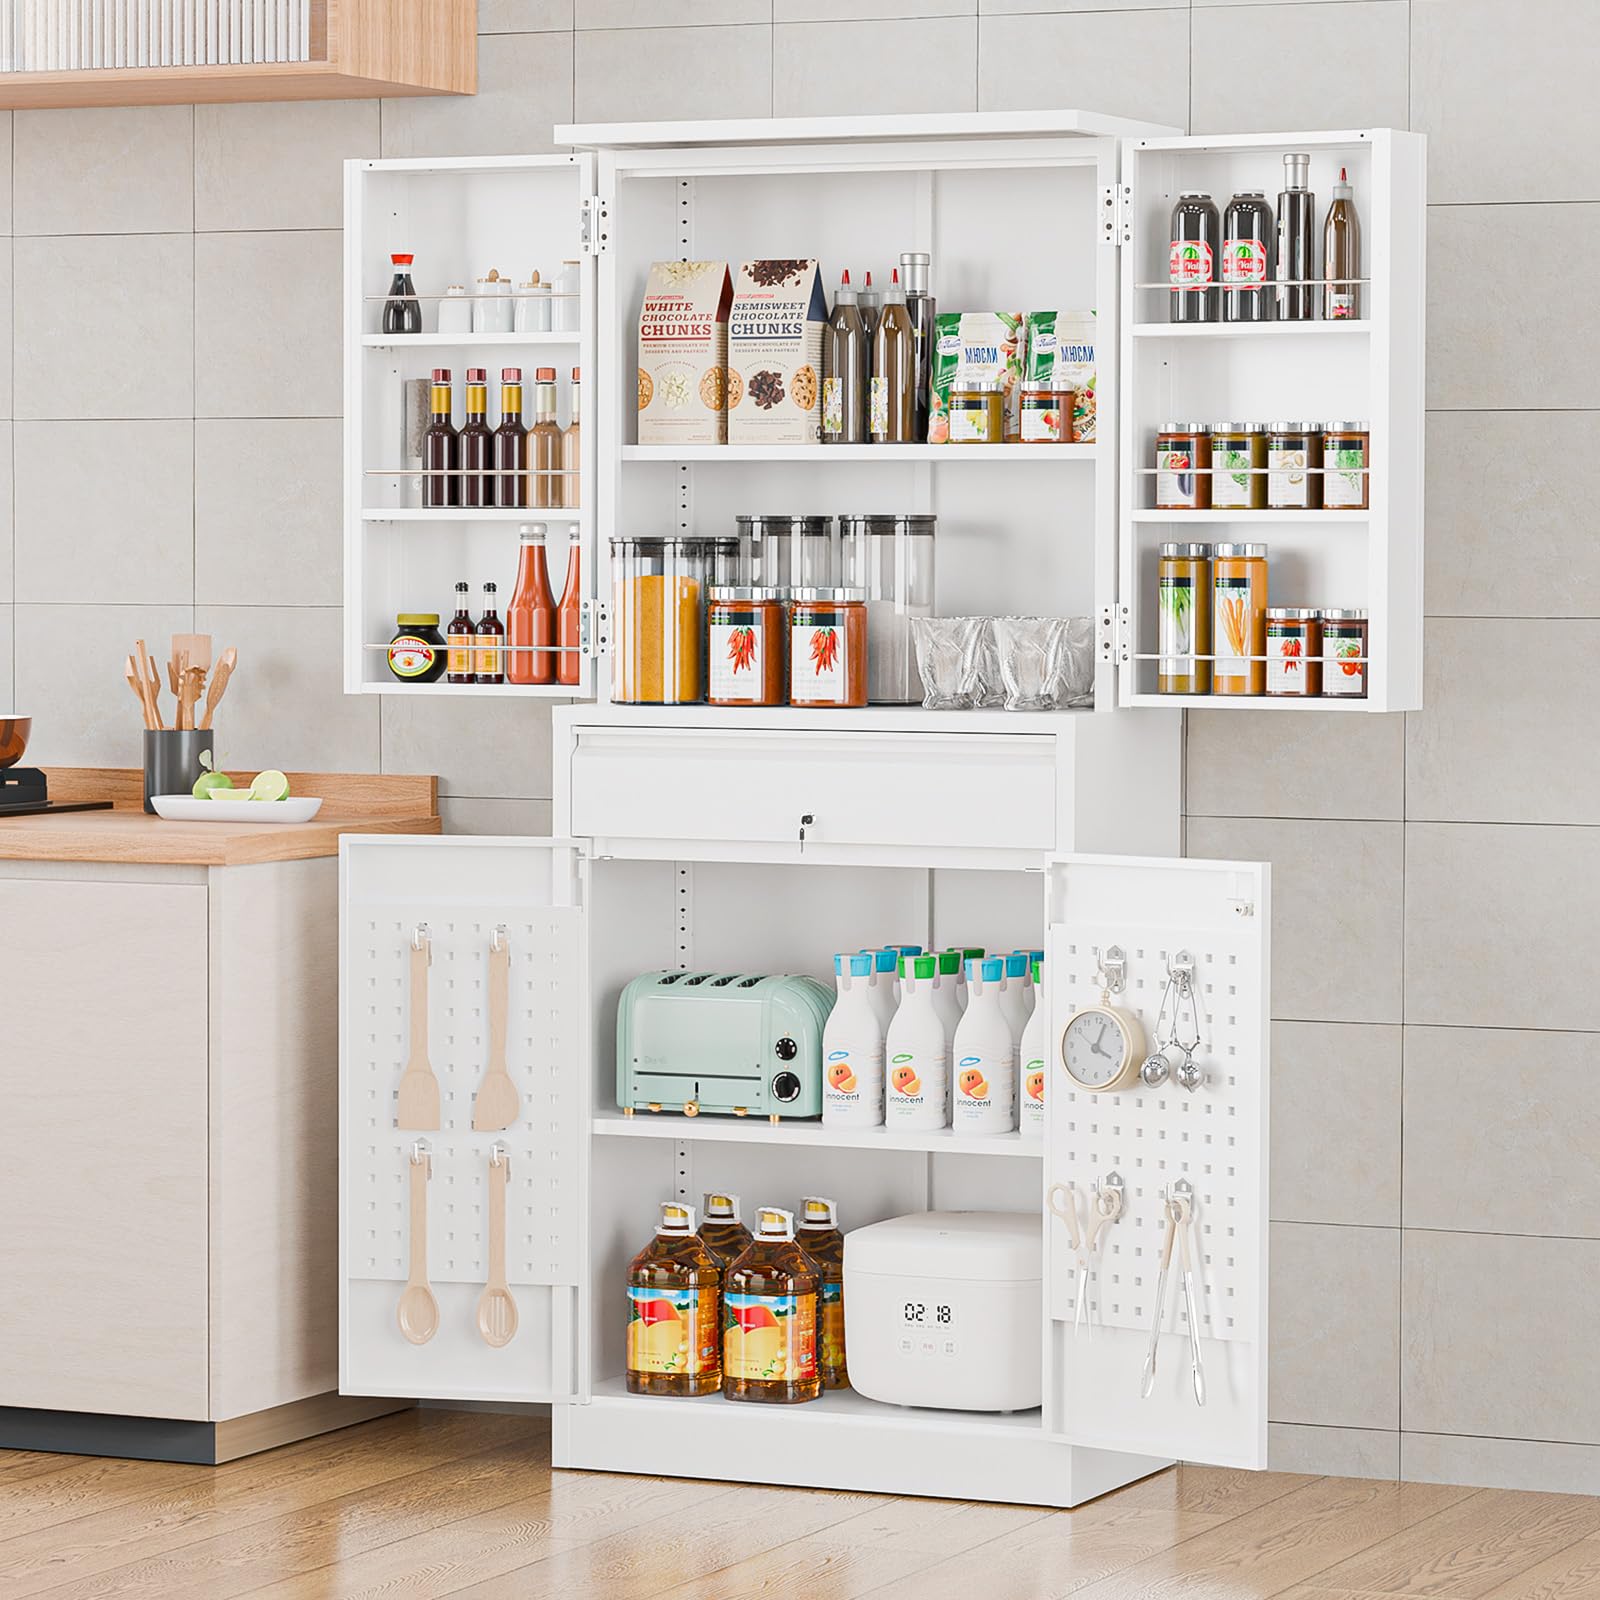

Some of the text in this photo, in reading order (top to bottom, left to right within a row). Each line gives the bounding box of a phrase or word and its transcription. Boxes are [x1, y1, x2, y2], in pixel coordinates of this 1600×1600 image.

[645, 303, 693, 311] WHITE
[734, 303, 806, 311] SEMISWEET
[642, 314, 712, 322] CHOCOLATE
[732, 312, 804, 320] CHOCOLATE
[641, 324, 711, 336] CHUNKS
[731, 323, 802, 335] CHUNKS
[965, 347, 998, 364] МЮСЛИ
[1061, 345, 1095, 362] МЮСЛИ
[1093, 1071, 1098, 1080] 6
[825, 1092, 859, 1101] innocent
[890, 1096, 924, 1104] innocent
[957, 1099, 991, 1107] innocent
